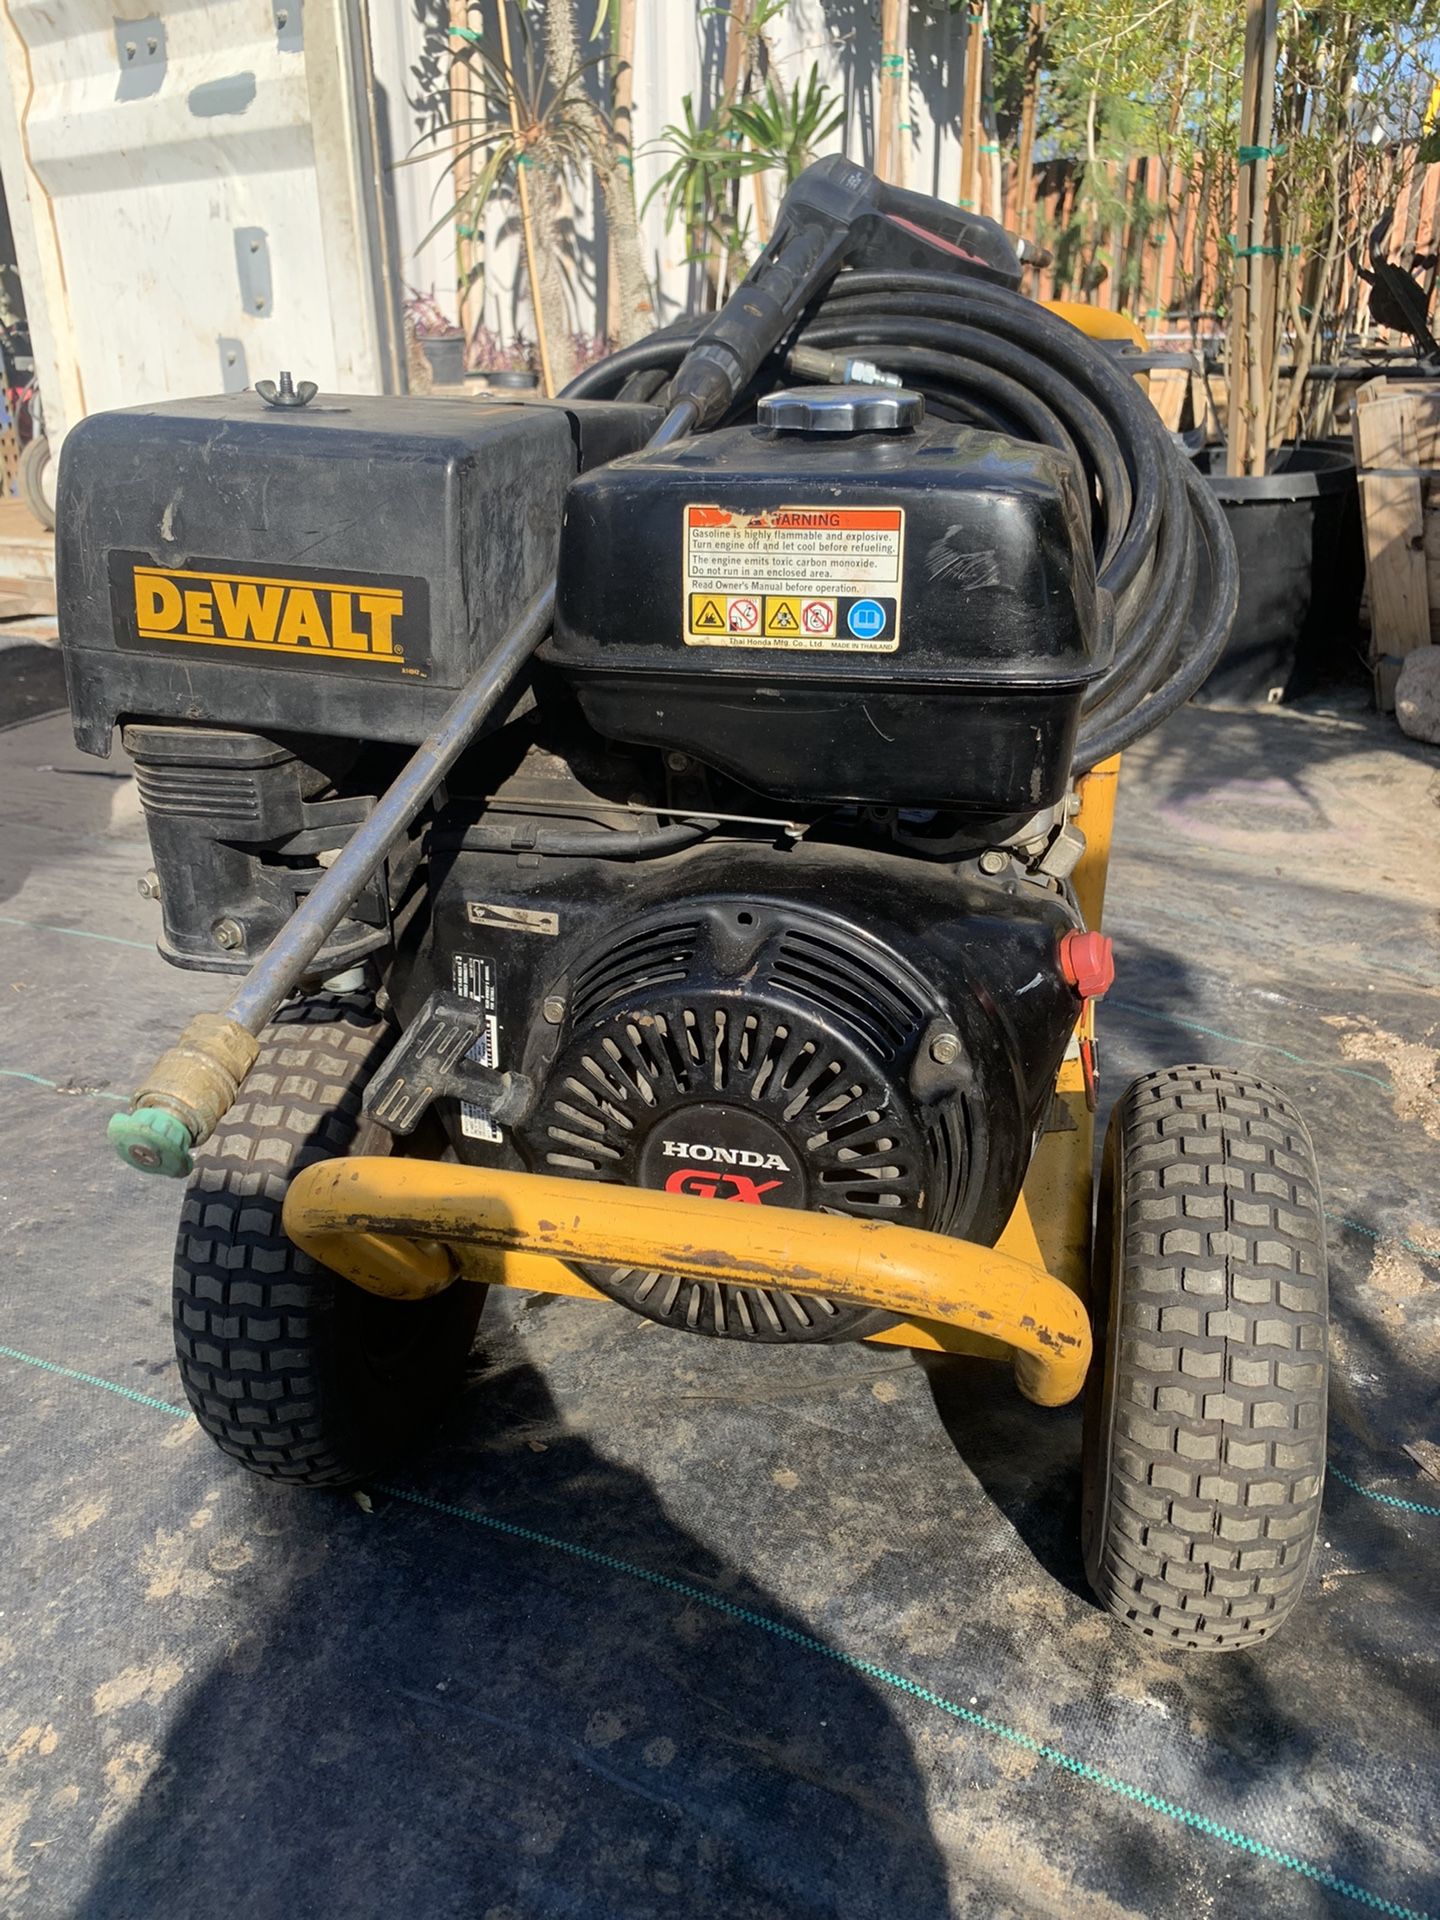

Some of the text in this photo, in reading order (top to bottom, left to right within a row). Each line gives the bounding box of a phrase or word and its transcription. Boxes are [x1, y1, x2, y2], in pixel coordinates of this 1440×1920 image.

[692, 529, 891, 542] Gasoline is highly flammable and explosive.
[693, 540, 895, 554] Turn engine off and let cool before refueling.
[693, 555, 877, 568] The engine emits toxic carbon monoxide.
[692, 566, 704, 574] Do
[707, 567, 720, 575] not
[742, 567, 750, 576] in
[767, 568, 806, 577] enclosed
[810, 570, 832, 578] area.
[692, 580, 859, 594] Read Owner's Manual before operation.
[662, 1140, 790, 1171] HONDA
[665, 1169, 784, 1205] GX
